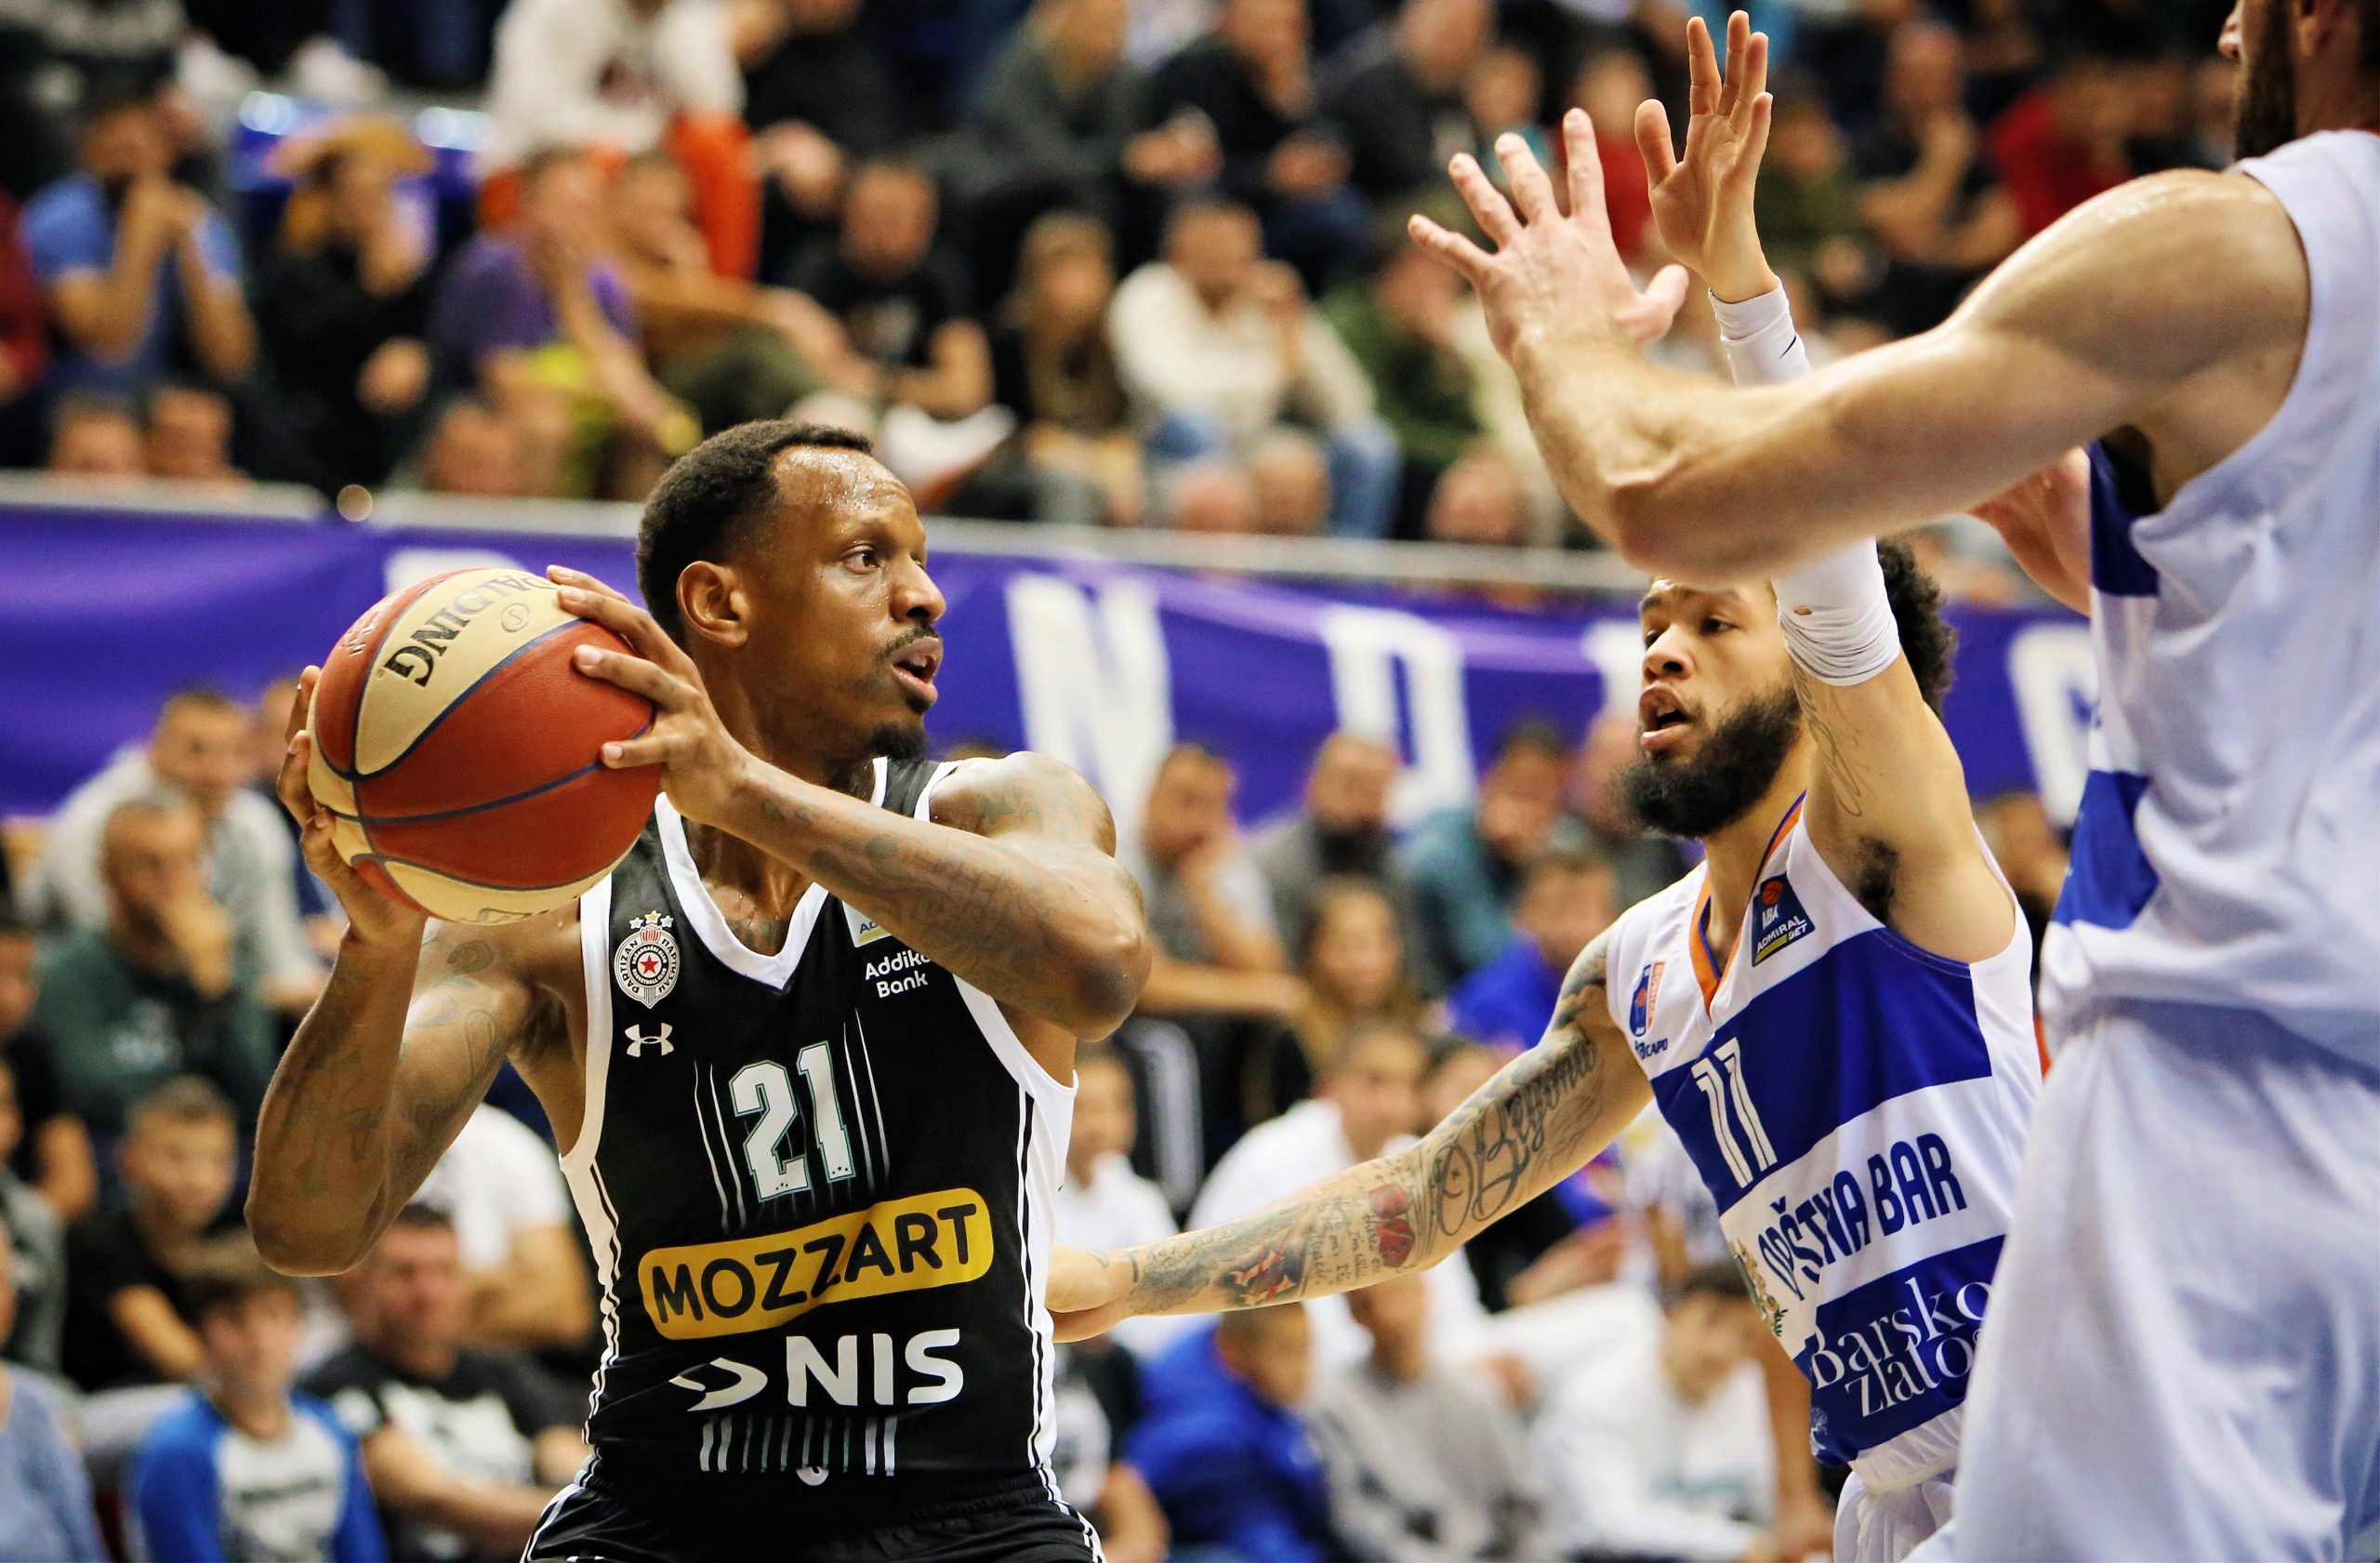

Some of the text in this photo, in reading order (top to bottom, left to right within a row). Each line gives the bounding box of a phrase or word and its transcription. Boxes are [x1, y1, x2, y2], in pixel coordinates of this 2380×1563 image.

[383, 575, 559, 687] PALDING
[619, 939, 640, 994] PARTIZAN
[876, 970, 929, 999] Bank
[1756, 916, 1805, 954] ADMIRAL
[728, 1040, 857, 1203] 21
[1691, 1037, 1777, 1188] 11
[1867, 1133, 1968, 1237] BAR
[652, 1203, 978, 1324] MOZZART
[787, 1328, 964, 1408] NIS
[1811, 1277, 1992, 1389] Barsko
